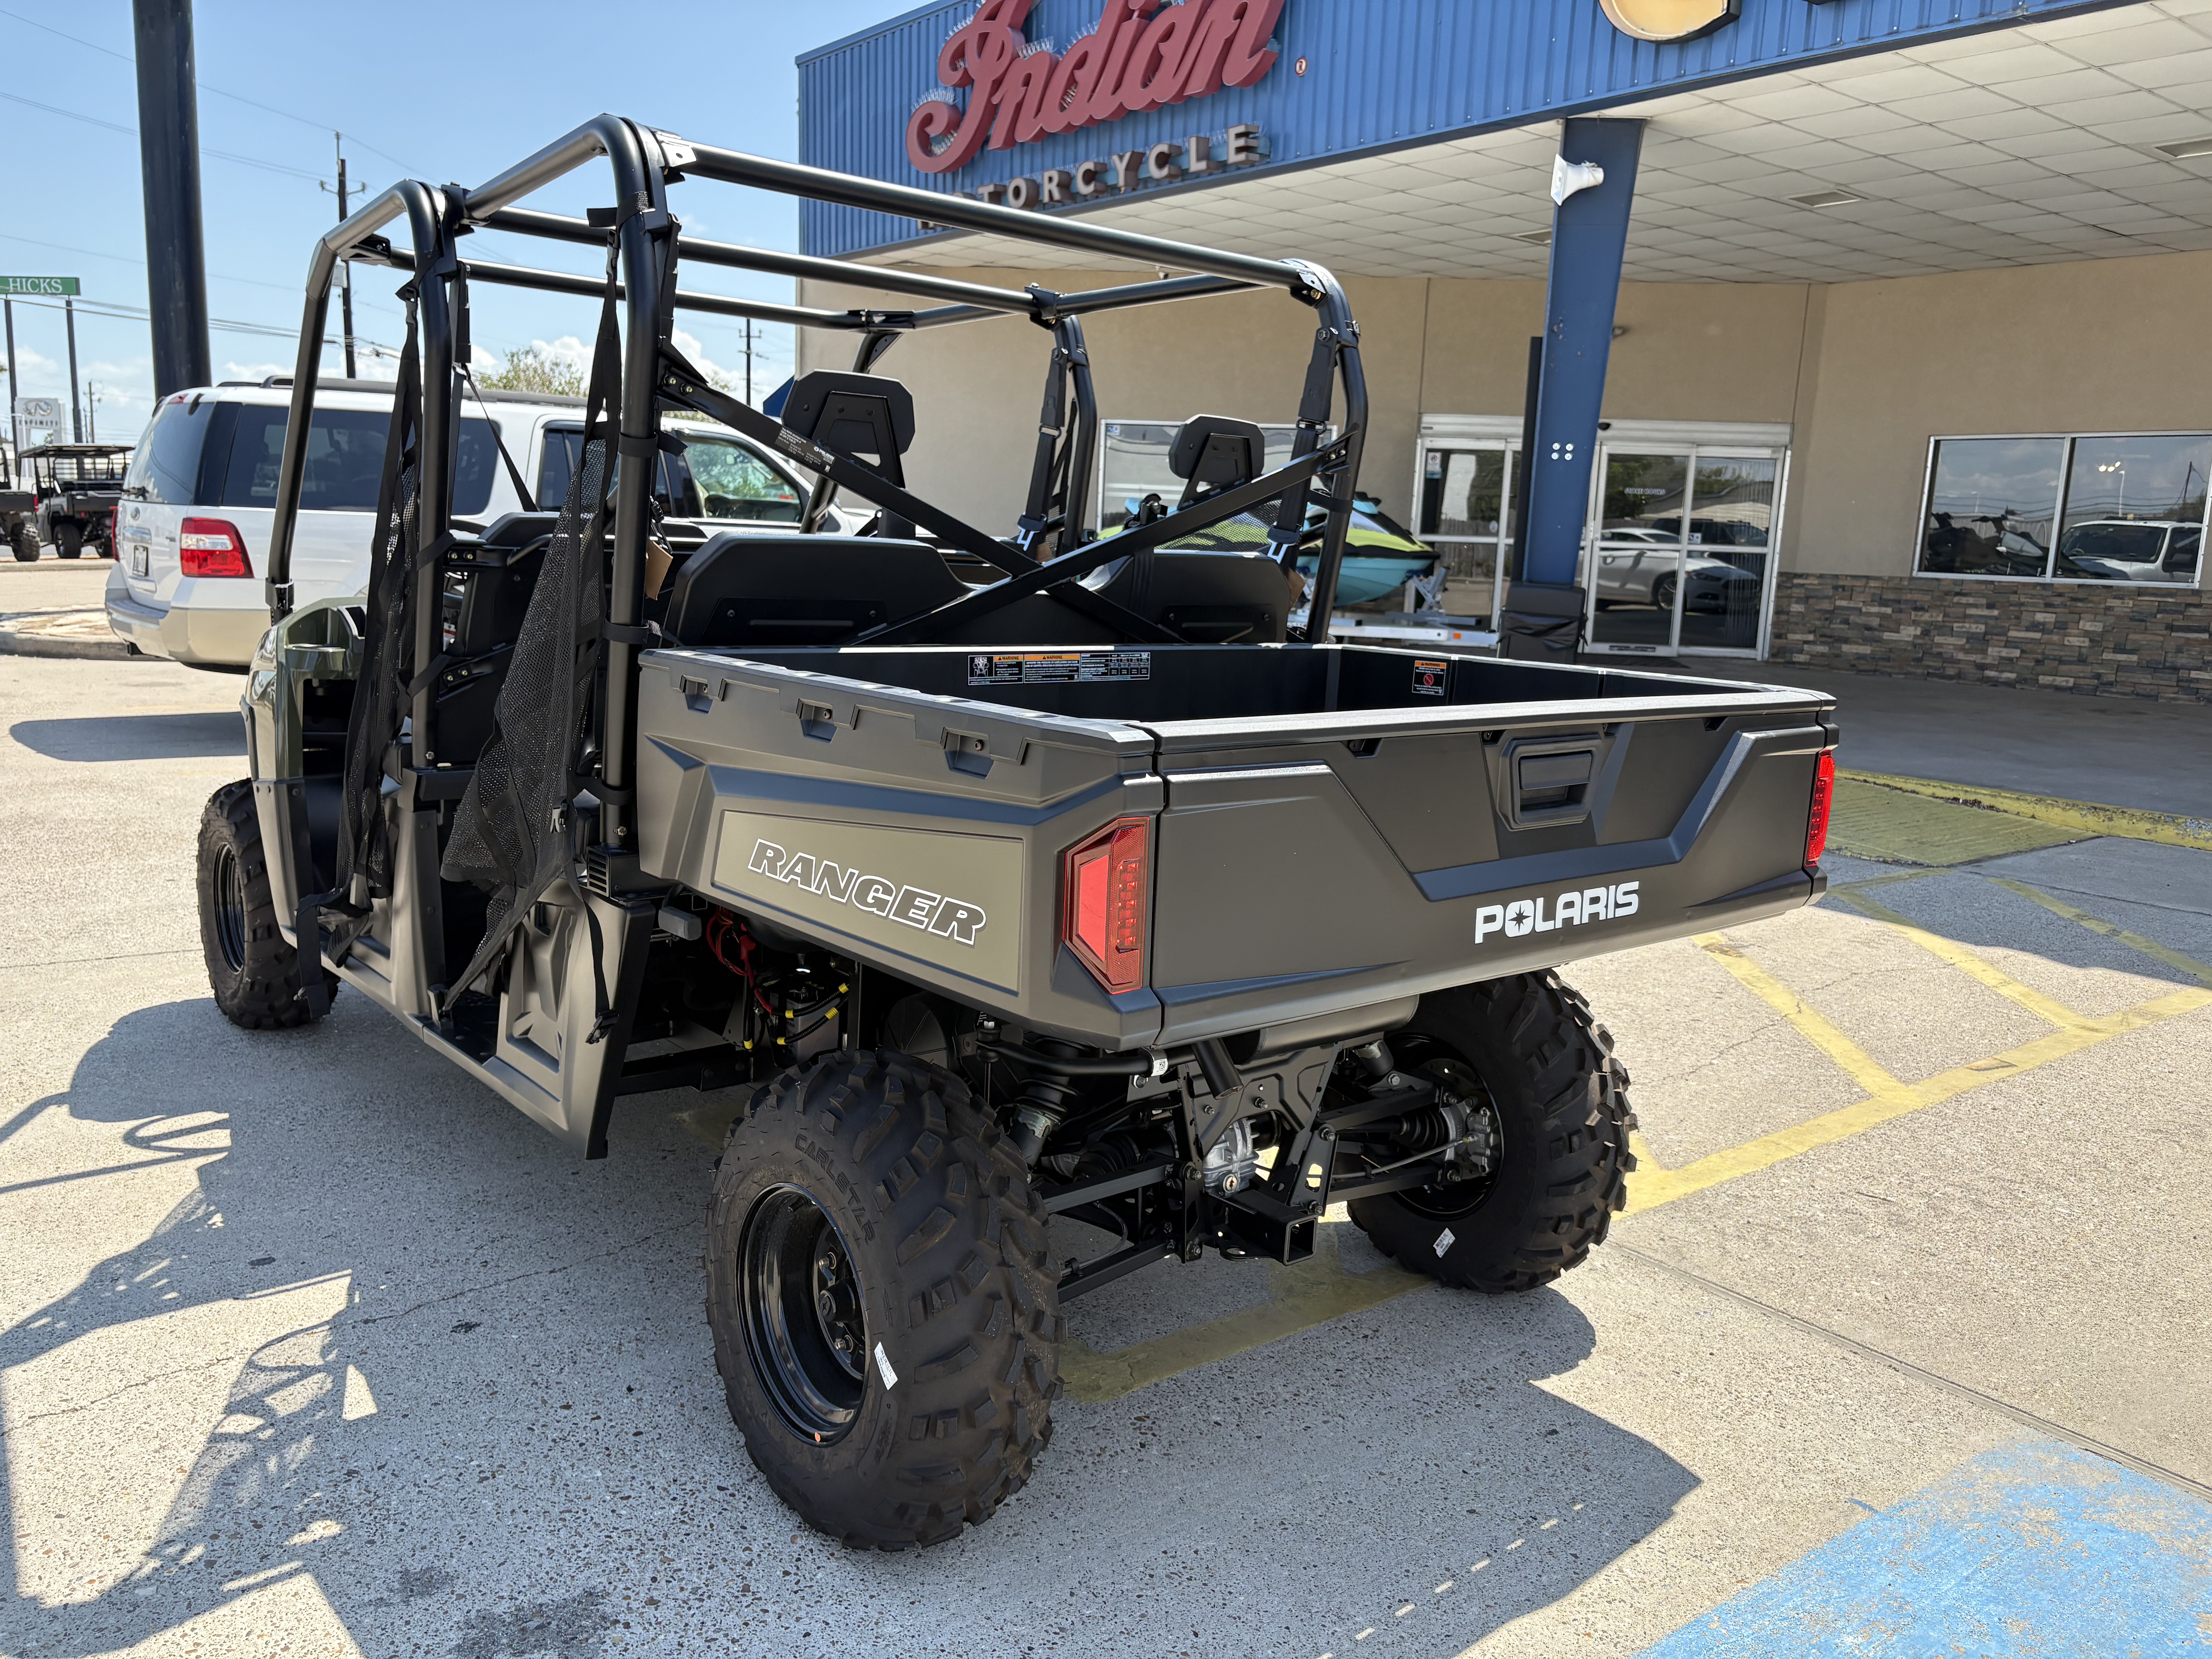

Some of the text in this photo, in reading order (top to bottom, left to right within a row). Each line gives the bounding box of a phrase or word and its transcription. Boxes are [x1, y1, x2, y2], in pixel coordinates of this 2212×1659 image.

[9, 278, 63, 294] HICKS
[747, 838, 987, 946] RANGER
[1474, 881, 1639, 944] POLARIS
